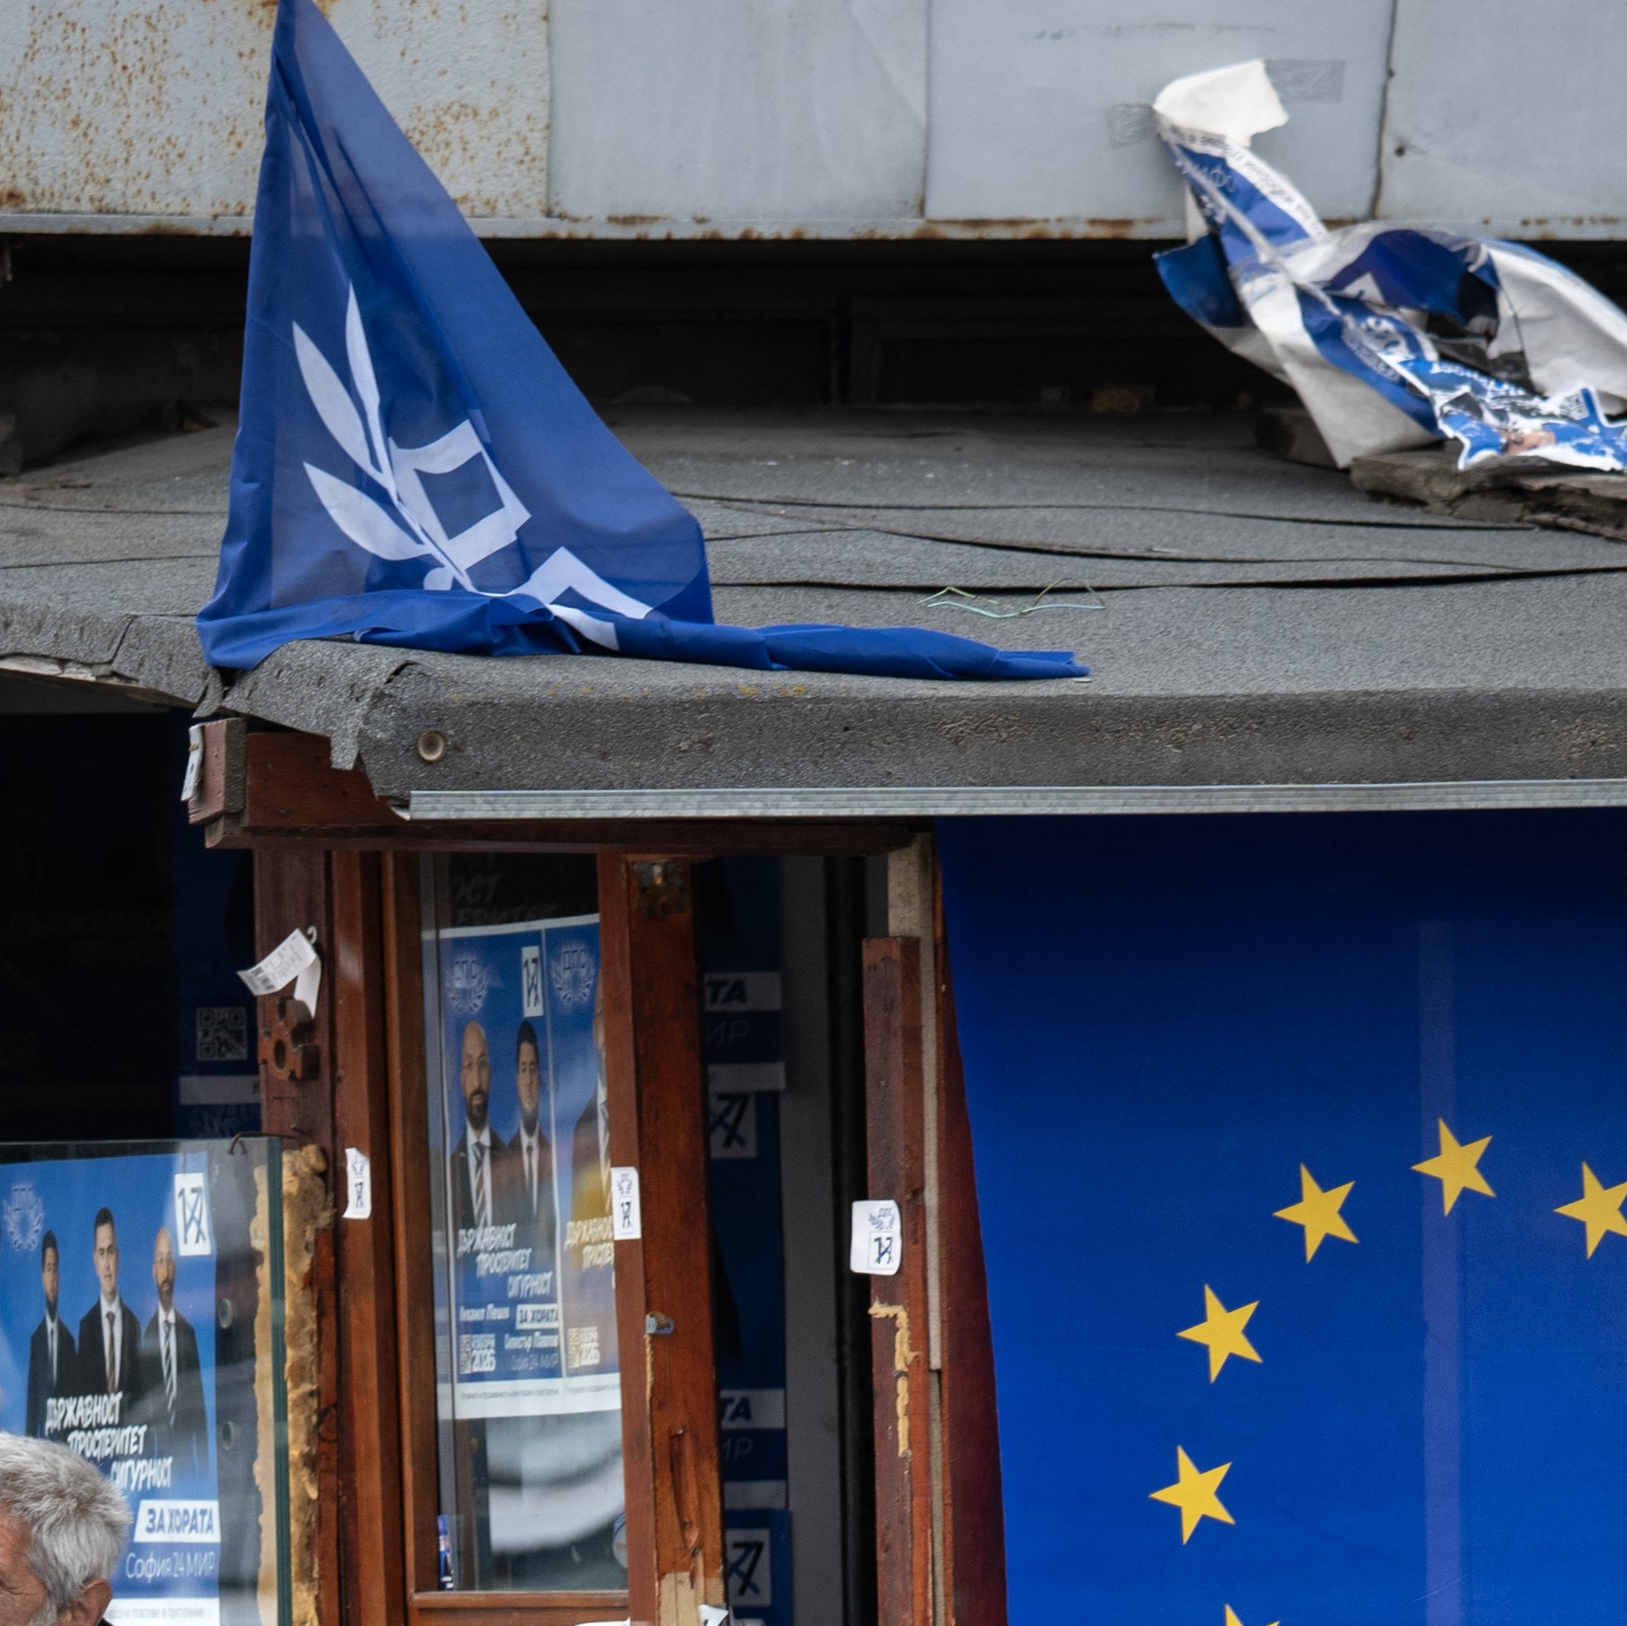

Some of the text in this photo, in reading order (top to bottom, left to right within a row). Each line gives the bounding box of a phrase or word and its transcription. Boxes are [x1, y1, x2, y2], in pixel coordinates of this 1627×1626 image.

[178, 1187, 205, 1245] 17
[145, 1508, 215, 1534] ЗА ХОРАТА
